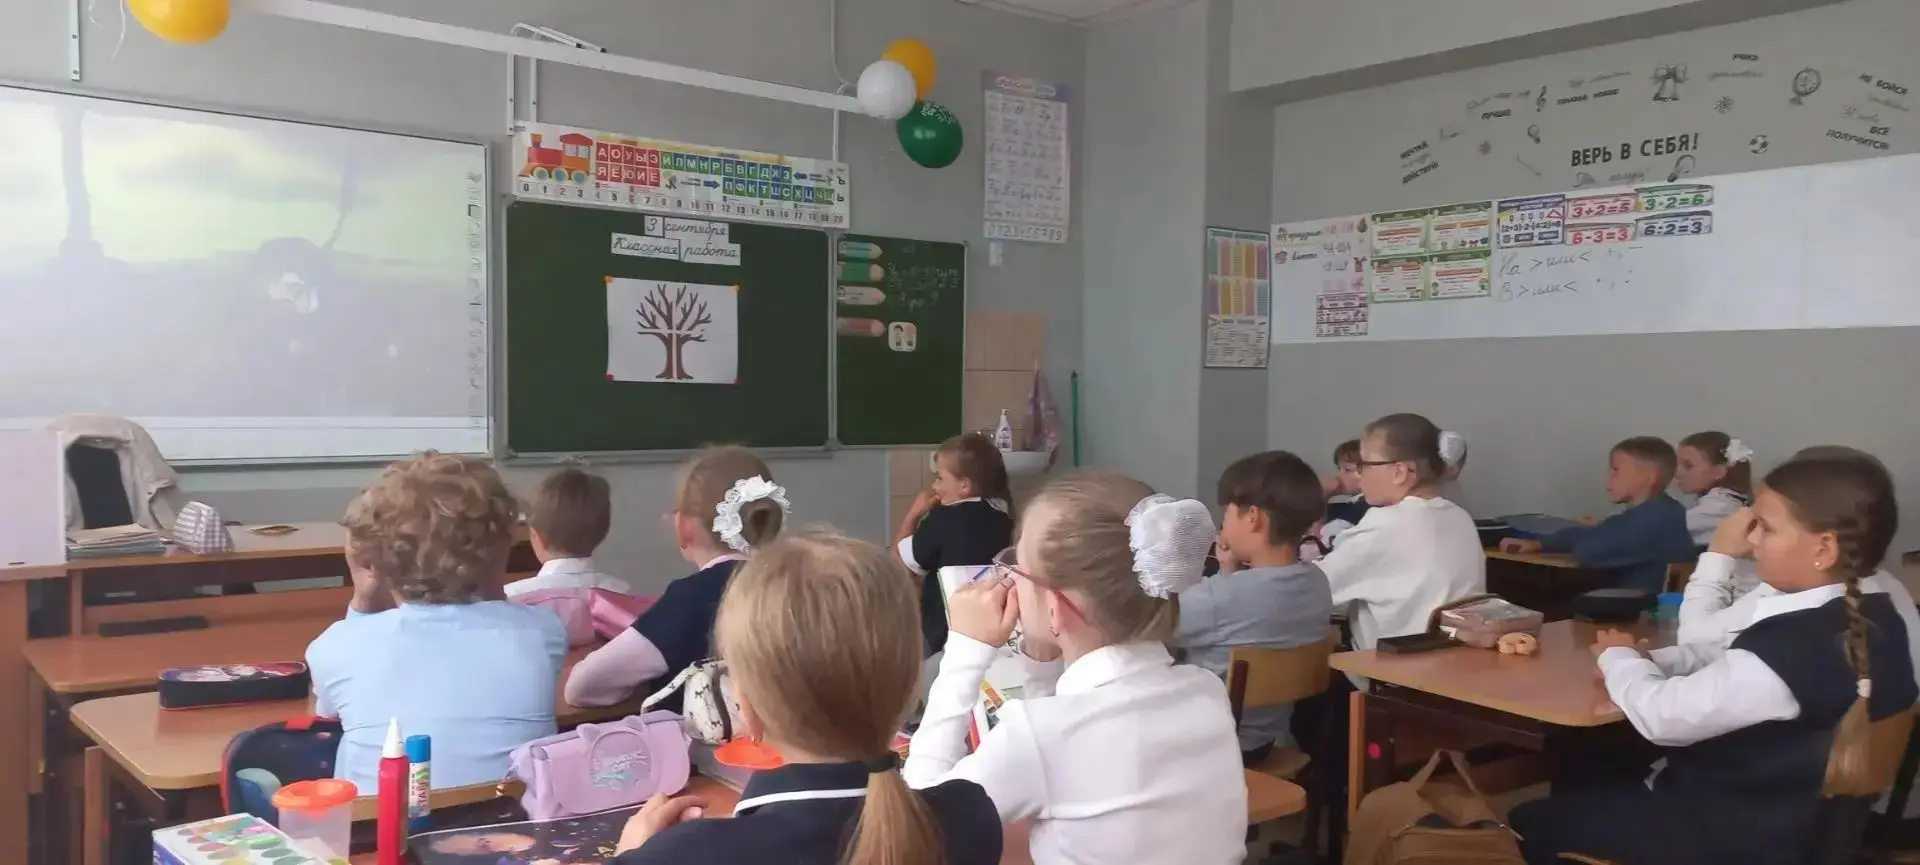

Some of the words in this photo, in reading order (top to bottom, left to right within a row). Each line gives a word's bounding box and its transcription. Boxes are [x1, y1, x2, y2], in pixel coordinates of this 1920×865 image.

[1571, 145, 1612, 167] ВЕРЬ
[1620, 143, 1631, 160] В
[1640, 132, 1699, 157] СЕБЯ!
[646, 217, 658, 232] 3
[612, 236, 678, 256] Классная
[682, 241, 740, 261] работа
